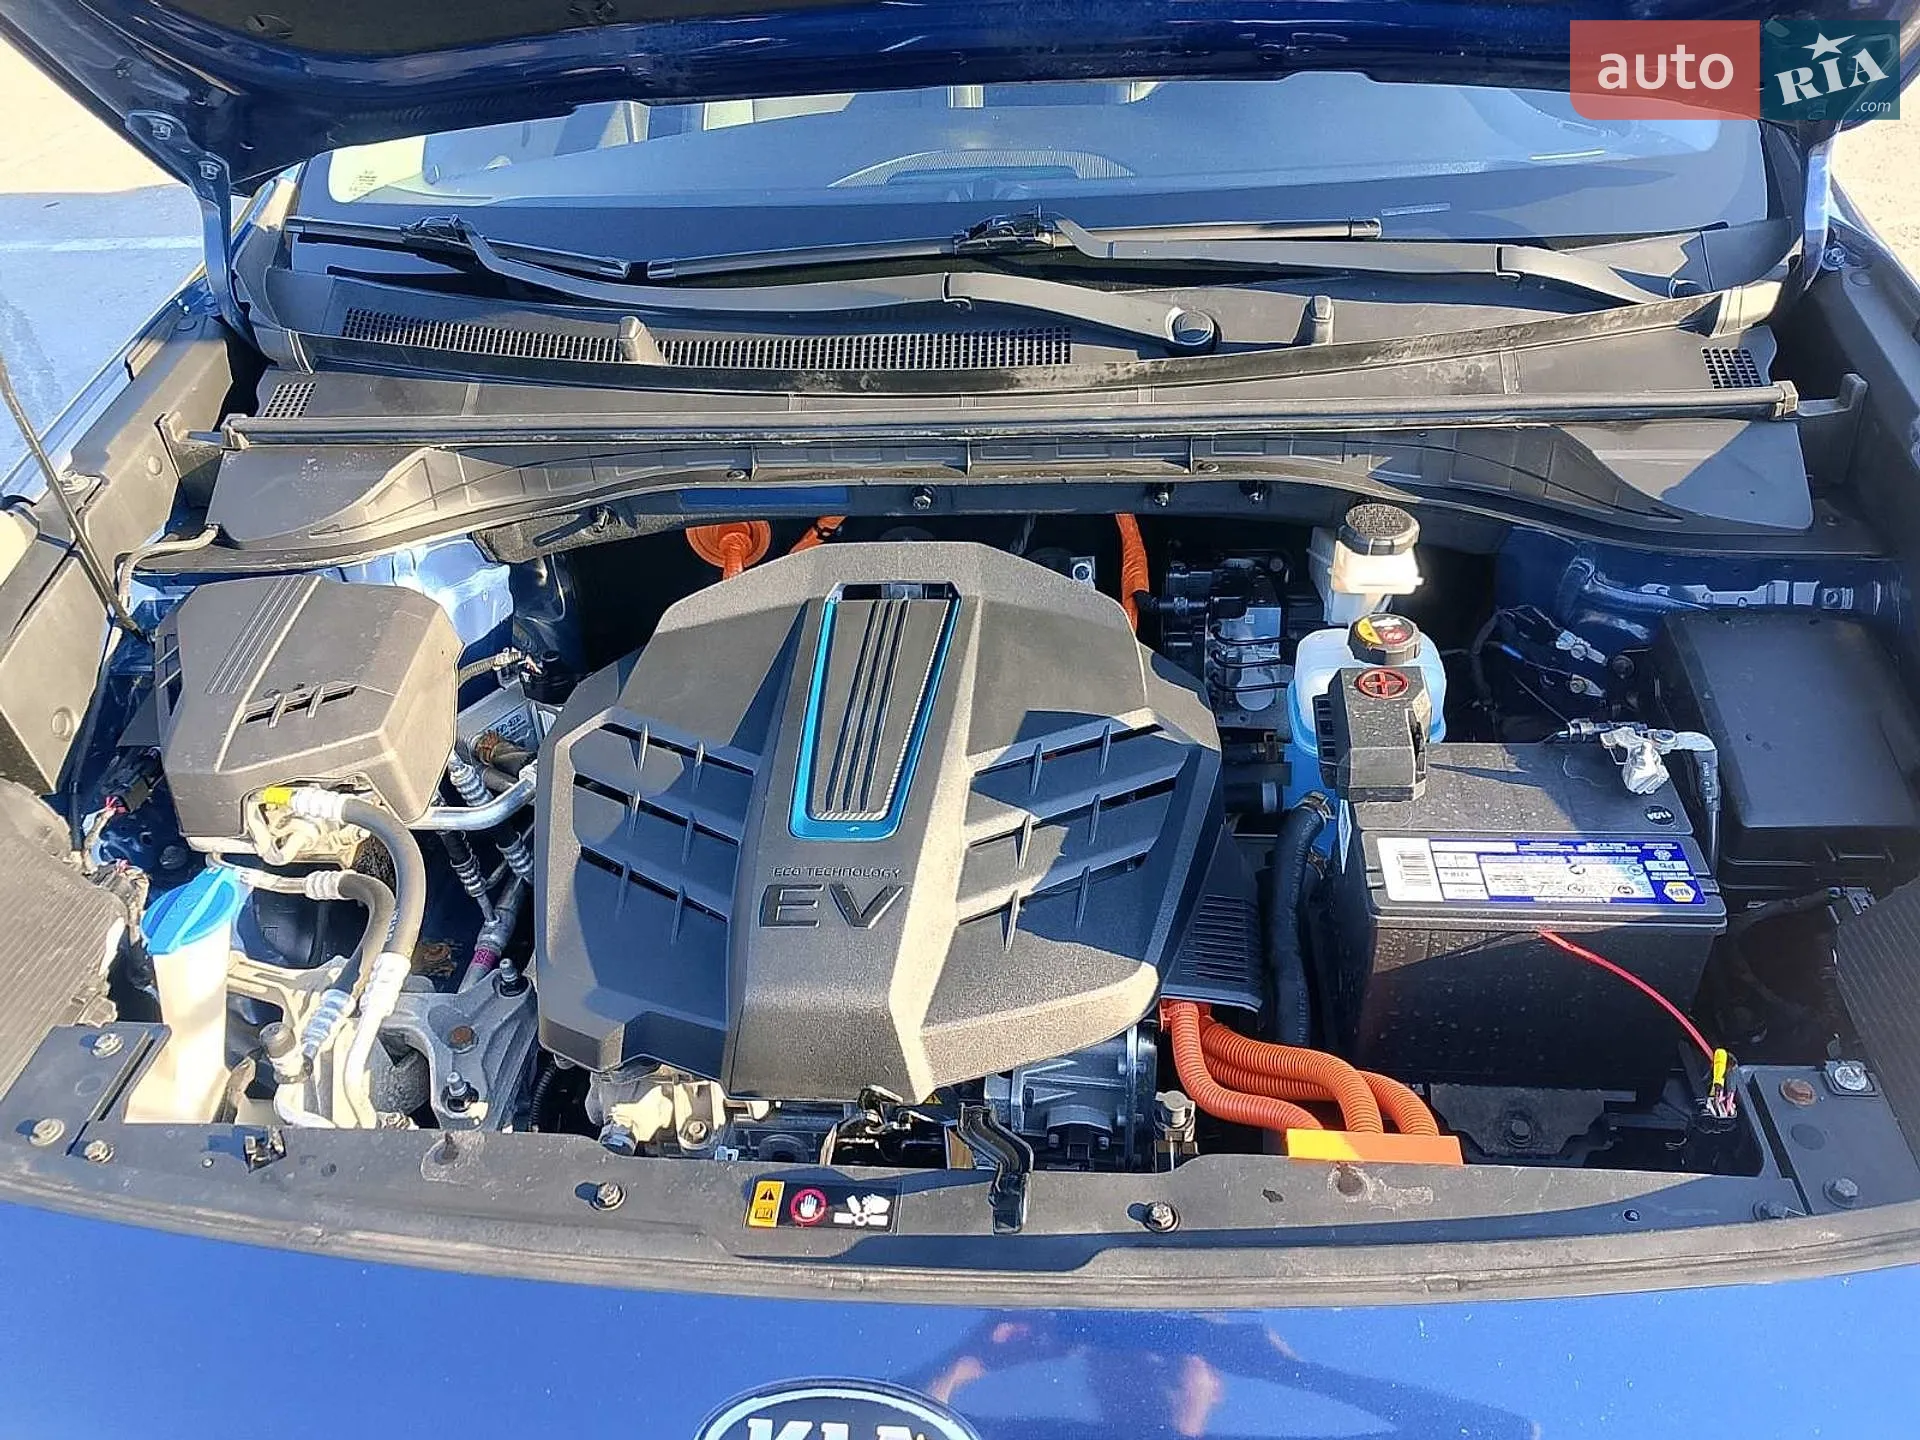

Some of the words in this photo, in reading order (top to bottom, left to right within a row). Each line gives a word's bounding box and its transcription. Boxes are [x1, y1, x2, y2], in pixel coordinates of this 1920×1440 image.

[772, 867, 802, 877] ECO
[807, 867, 902, 878] TECHNOLOGY
[759, 883, 905, 929] EV
